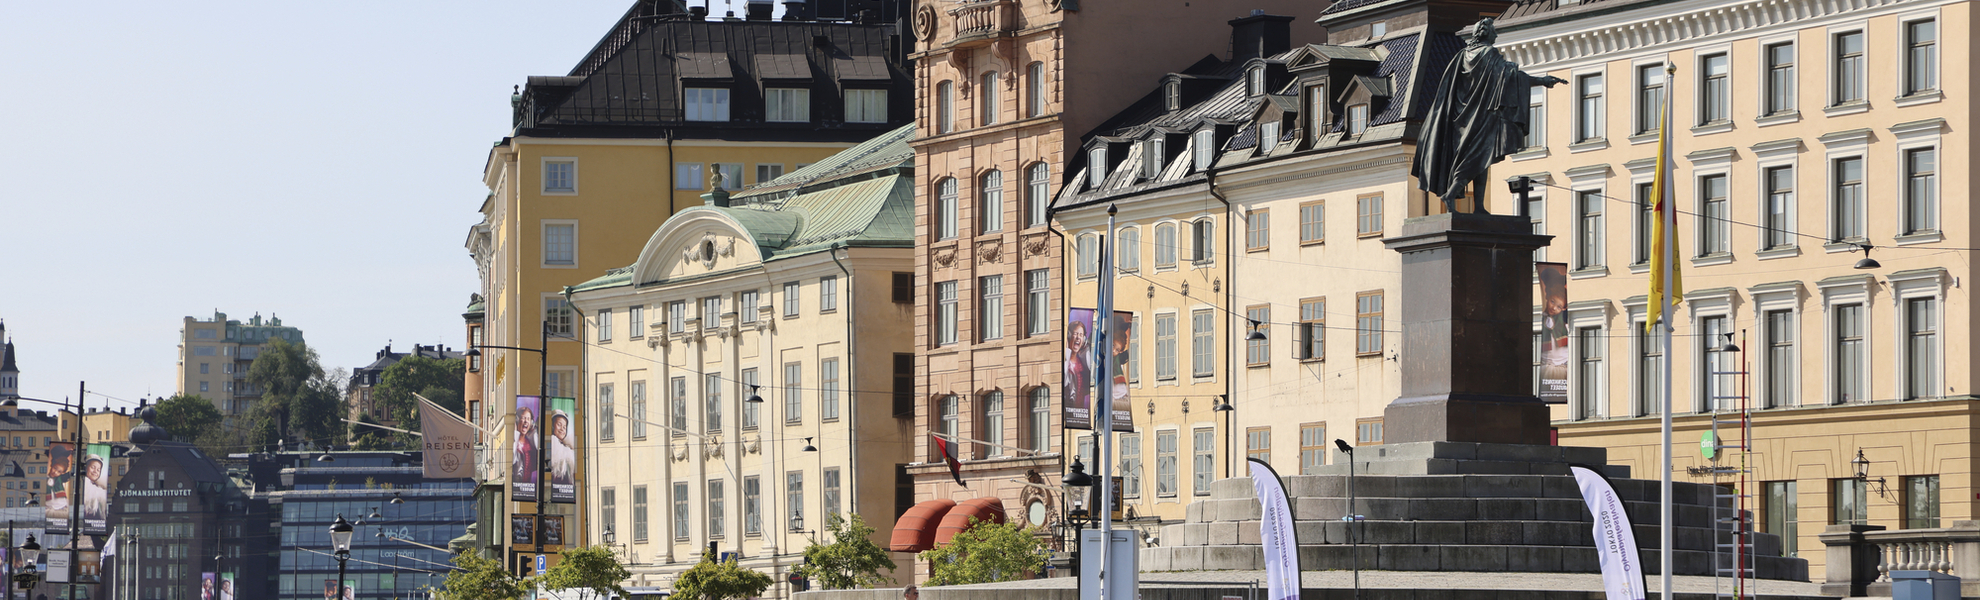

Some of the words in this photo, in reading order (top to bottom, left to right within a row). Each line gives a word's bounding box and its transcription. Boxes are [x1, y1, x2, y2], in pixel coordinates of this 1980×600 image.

[426, 442, 470, 450] REISEN
[119, 489, 192, 497] SJÖMANSINSTITUTET
[538, 557, 544, 570] P
